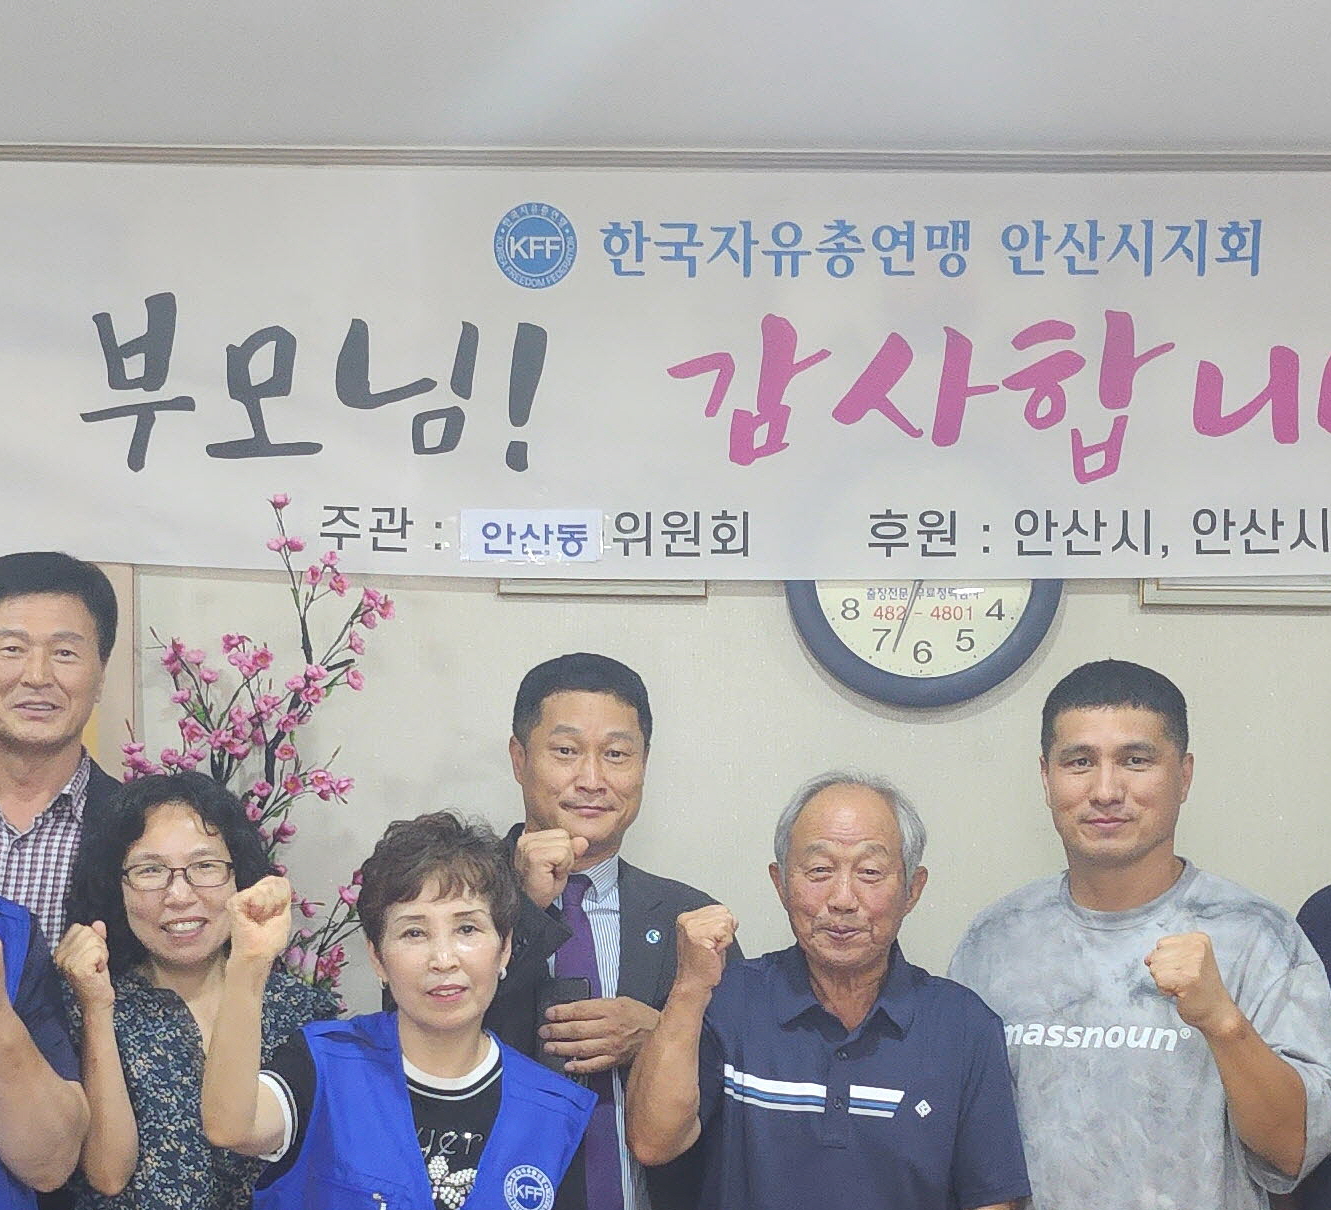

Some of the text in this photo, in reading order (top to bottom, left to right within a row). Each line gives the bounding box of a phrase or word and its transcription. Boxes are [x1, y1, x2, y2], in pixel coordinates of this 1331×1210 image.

[509, 235, 562, 260] KFF
[599, 219, 1263, 279] 한국자유총연맹 안산시지회
[79, 292, 549, 473] 부모님!
[320, 505, 414, 553] 주관
[481, 521, 588, 558] 안산동
[612, 509, 750, 557] 위원회
[867, 508, 958, 558] 후원
[1013, 508, 1170, 559] 안산시,
[840, 598, 1005, 621] 8 4
[871, 628, 976, 665] 7 6 5
[1003, 1022, 1178, 1051] massnoun
[514, 1183, 543, 1202] KFF
